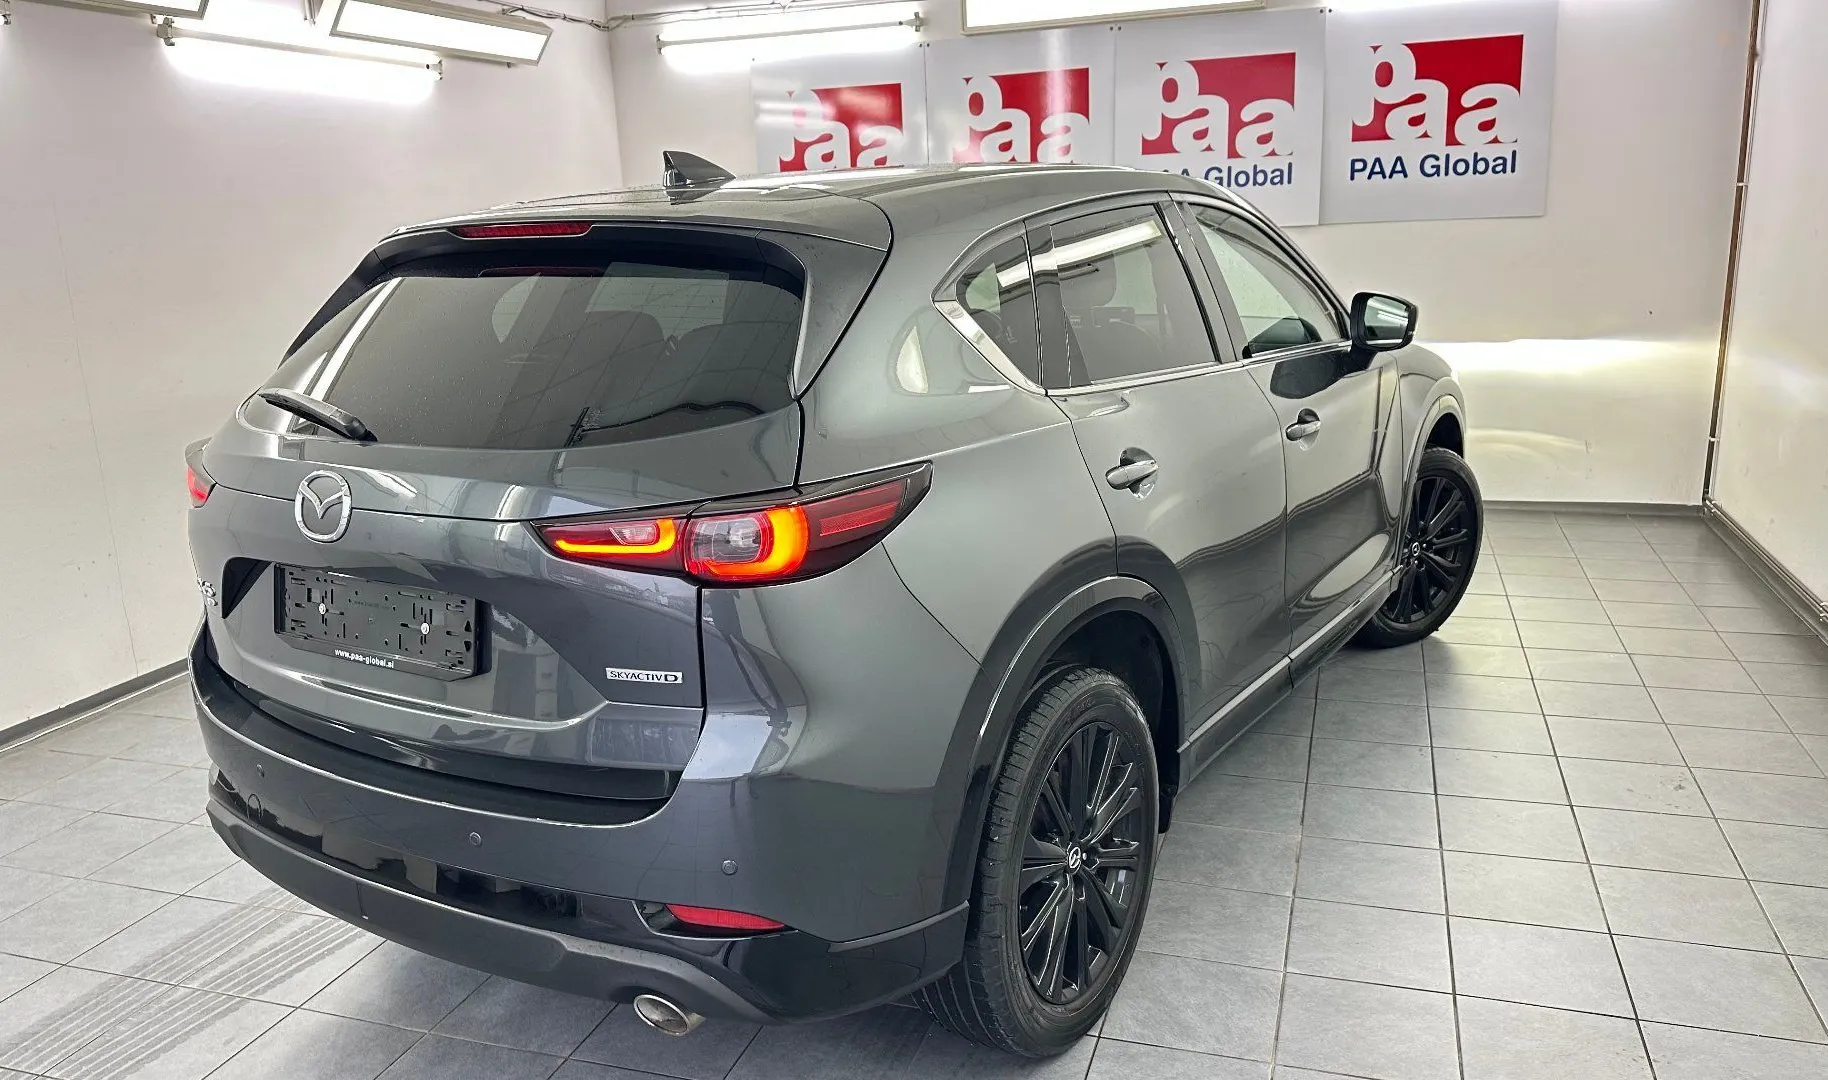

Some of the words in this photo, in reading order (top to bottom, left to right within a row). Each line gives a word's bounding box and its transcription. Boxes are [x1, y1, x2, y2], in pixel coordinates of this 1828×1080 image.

[1204, 162, 1293, 188] Global
[1350, 156, 1408, 181] PAA
[1419, 150, 1517, 178] Global
[334, 649, 395, 669] www.paa-global.si
